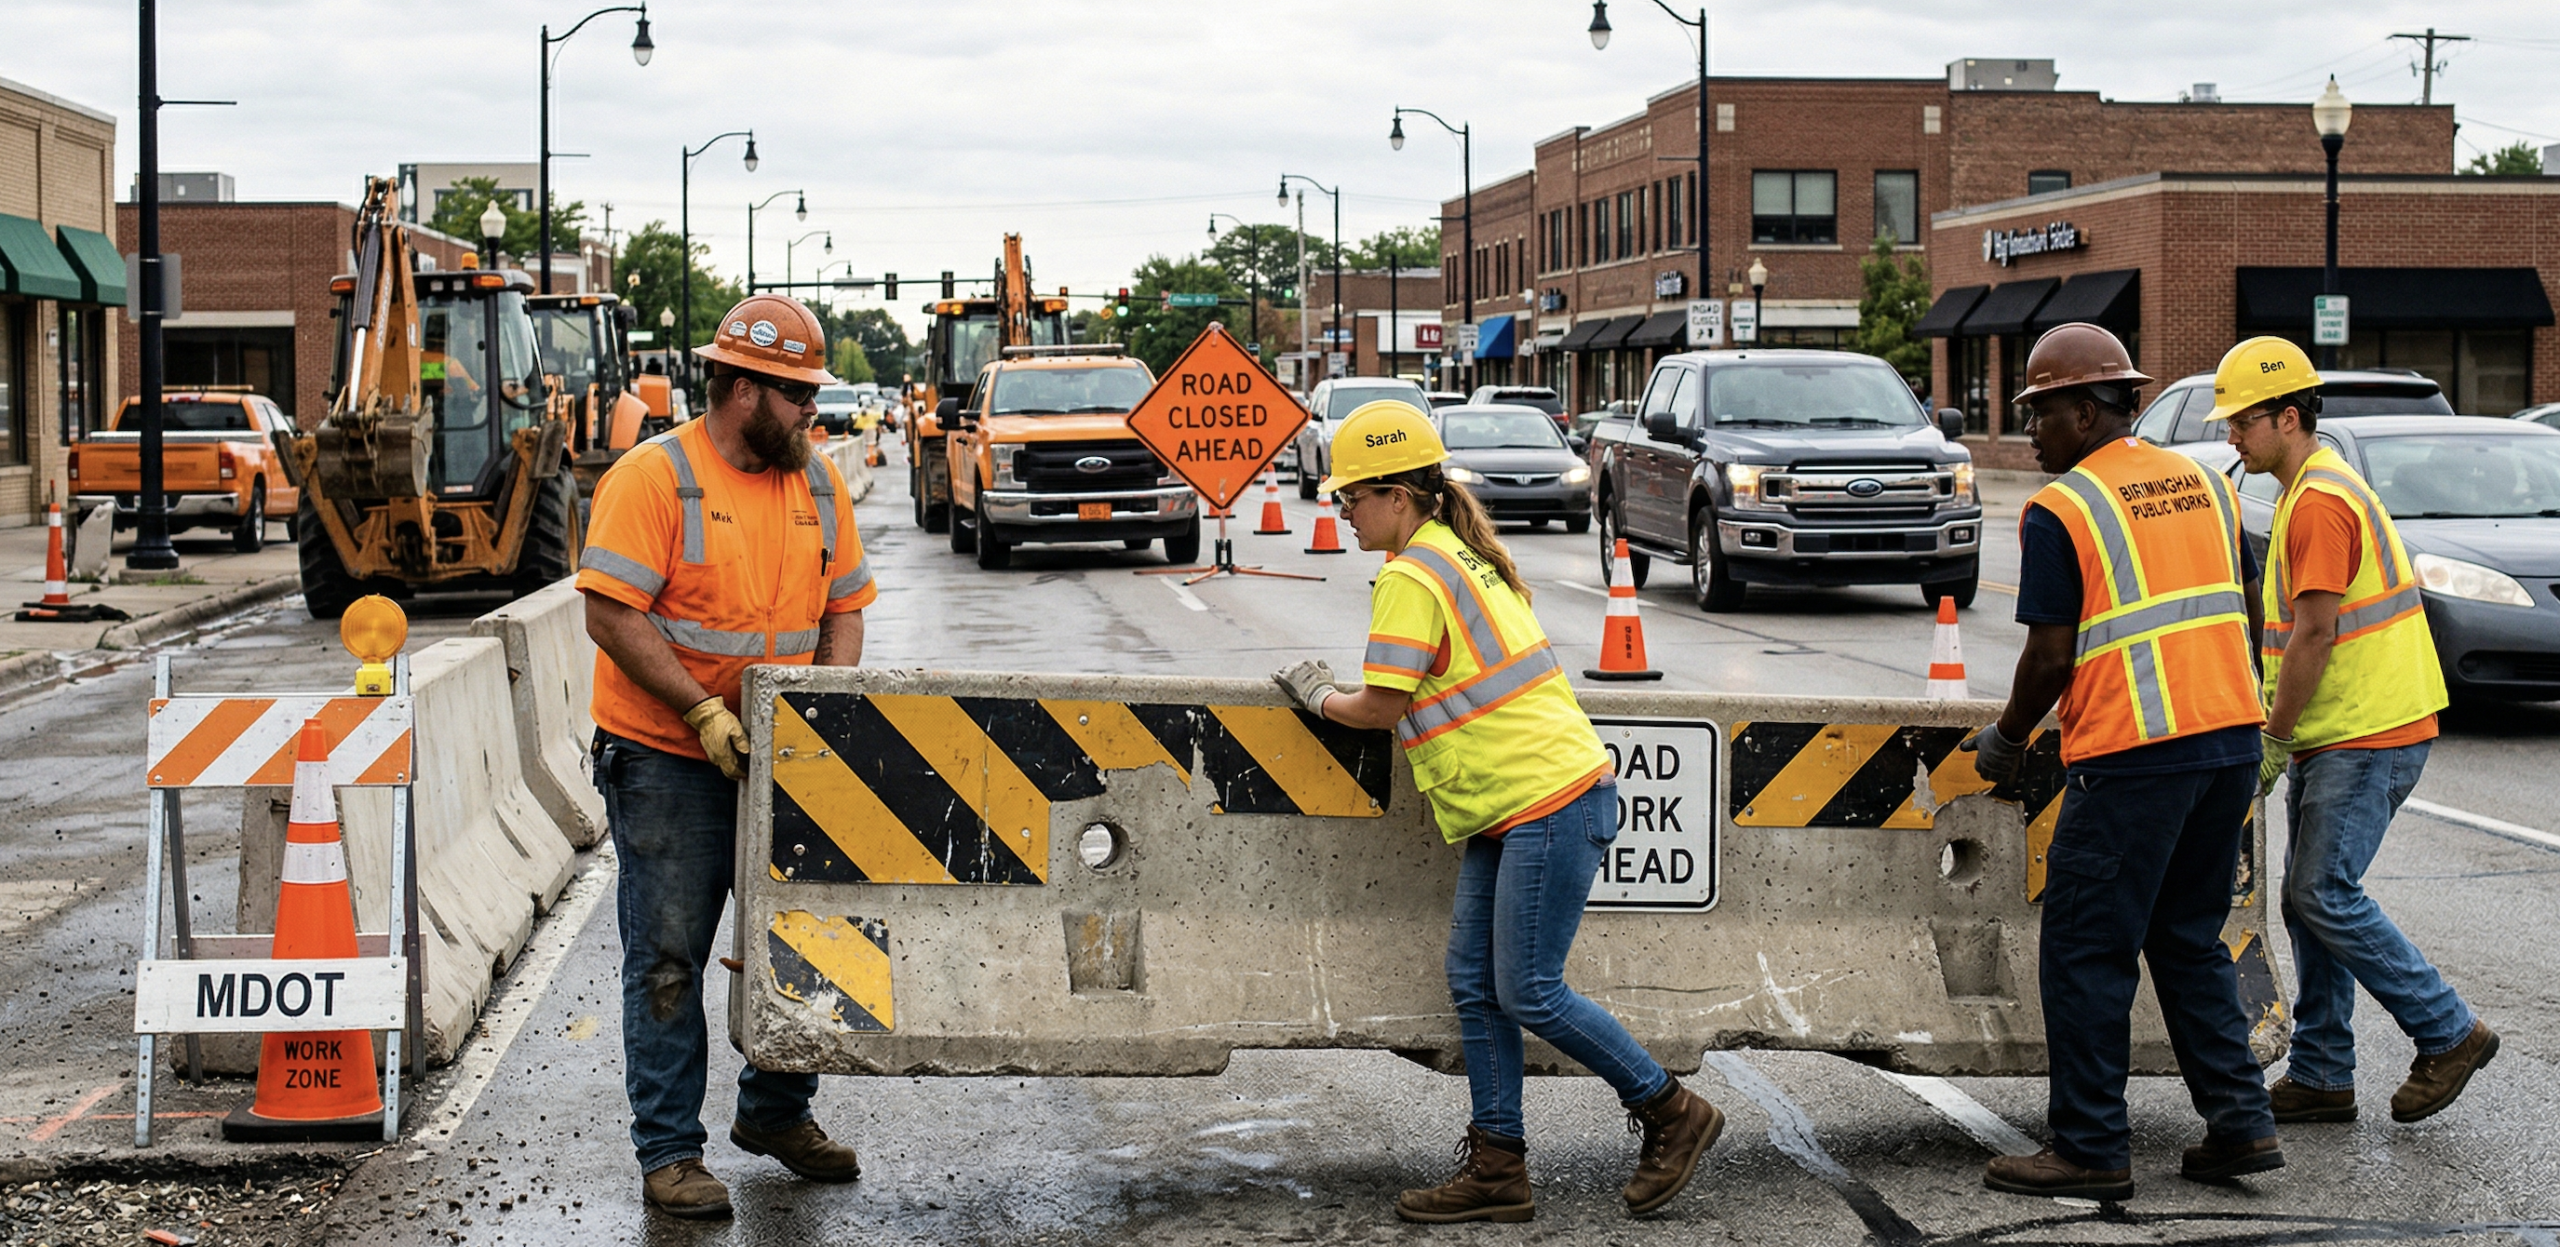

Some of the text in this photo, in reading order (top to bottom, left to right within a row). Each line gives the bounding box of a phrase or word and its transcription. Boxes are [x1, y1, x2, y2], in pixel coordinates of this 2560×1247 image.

[2260, 361, 2286, 374] Ben
[1181, 372, 1252, 396] ROAD
[1168, 404, 1267, 429] CLOSED
[1176, 438, 1263, 462] AHEAD
[1365, 429, 1407, 448] Sarah
[2131, 493, 2211, 520] PUBLIC WORKS
[1605, 743, 1681, 780] OAD
[1599, 847, 1695, 884] HEAD
[196, 972, 345, 1018] MDOT
[284, 1040, 342, 1060] WORK
[285, 1069, 342, 1088] ZONE
